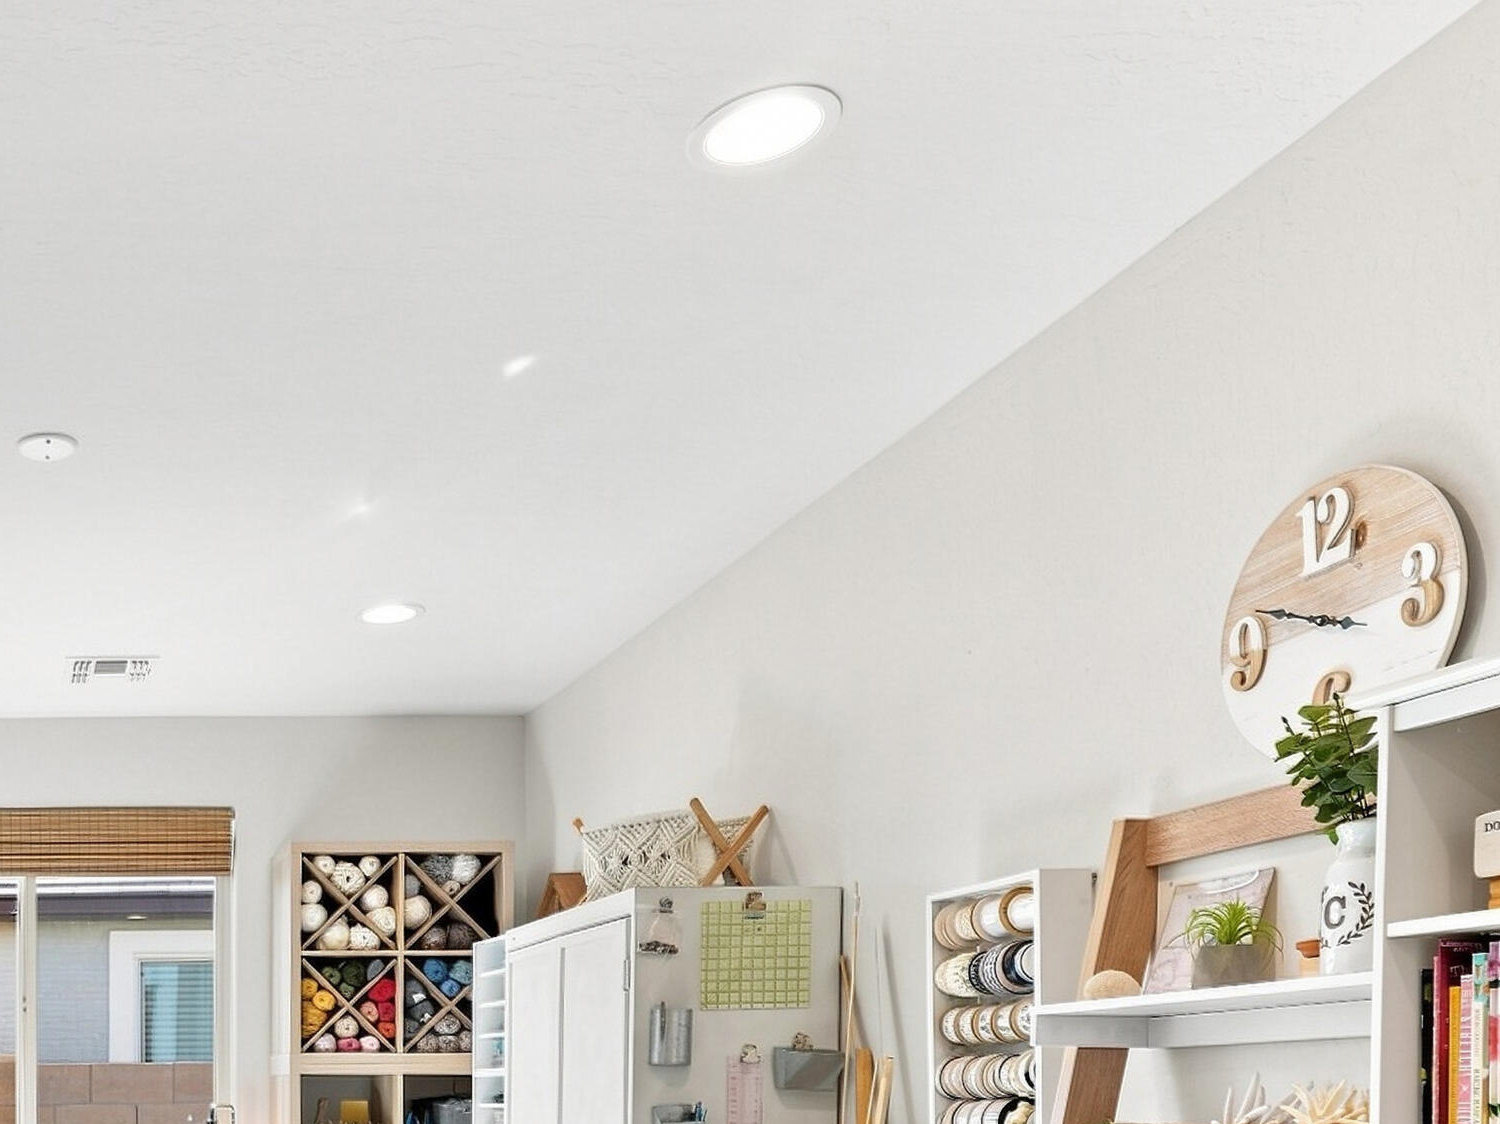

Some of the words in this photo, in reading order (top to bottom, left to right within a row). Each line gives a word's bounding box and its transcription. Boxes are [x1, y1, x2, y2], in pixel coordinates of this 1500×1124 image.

[1297, 487, 1356, 581] 12
[1400, 542, 1445, 627] 3
[1229, 615, 1267, 692] 9
[1324, 896, 1346, 929] C
